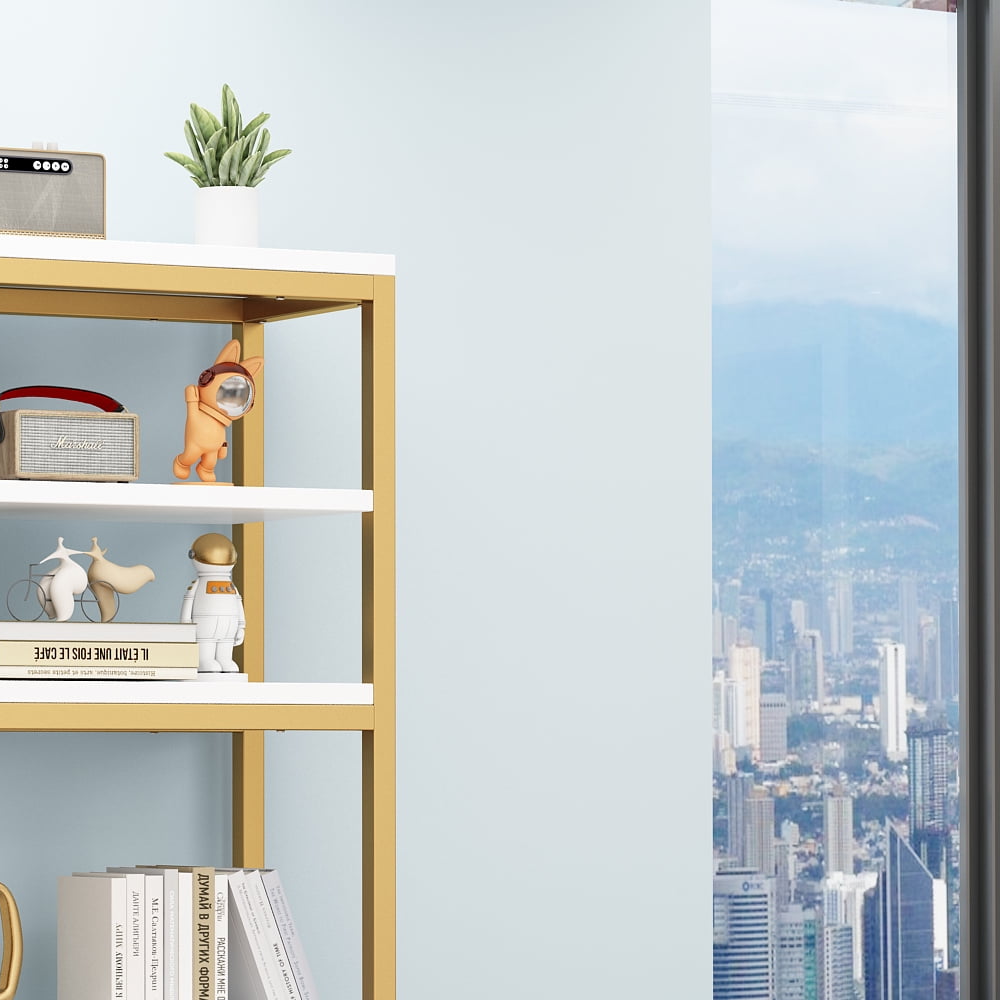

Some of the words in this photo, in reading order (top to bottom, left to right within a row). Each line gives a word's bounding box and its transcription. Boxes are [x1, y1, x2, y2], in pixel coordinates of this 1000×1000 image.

[34, 647, 57, 662] CAFÉ
[59, 647, 70, 660] LE
[72, 647, 92, 661] FOIS
[94, 648, 112, 661] UNE
[114, 648, 139, 663] ÉTAIT
[141, 648, 149, 661] IL
[197, 873, 211, 910] ДУМАЙ
[197, 923, 210, 963] ДРУГИХ
[272, 943, 281, 958] TIME
[217, 937, 226, 976] РАССКАЖИ
[278, 959, 285, 968] OF
[217, 978, 226, 994] МНЕ
[282, 969, 294, 995] HISTORY
